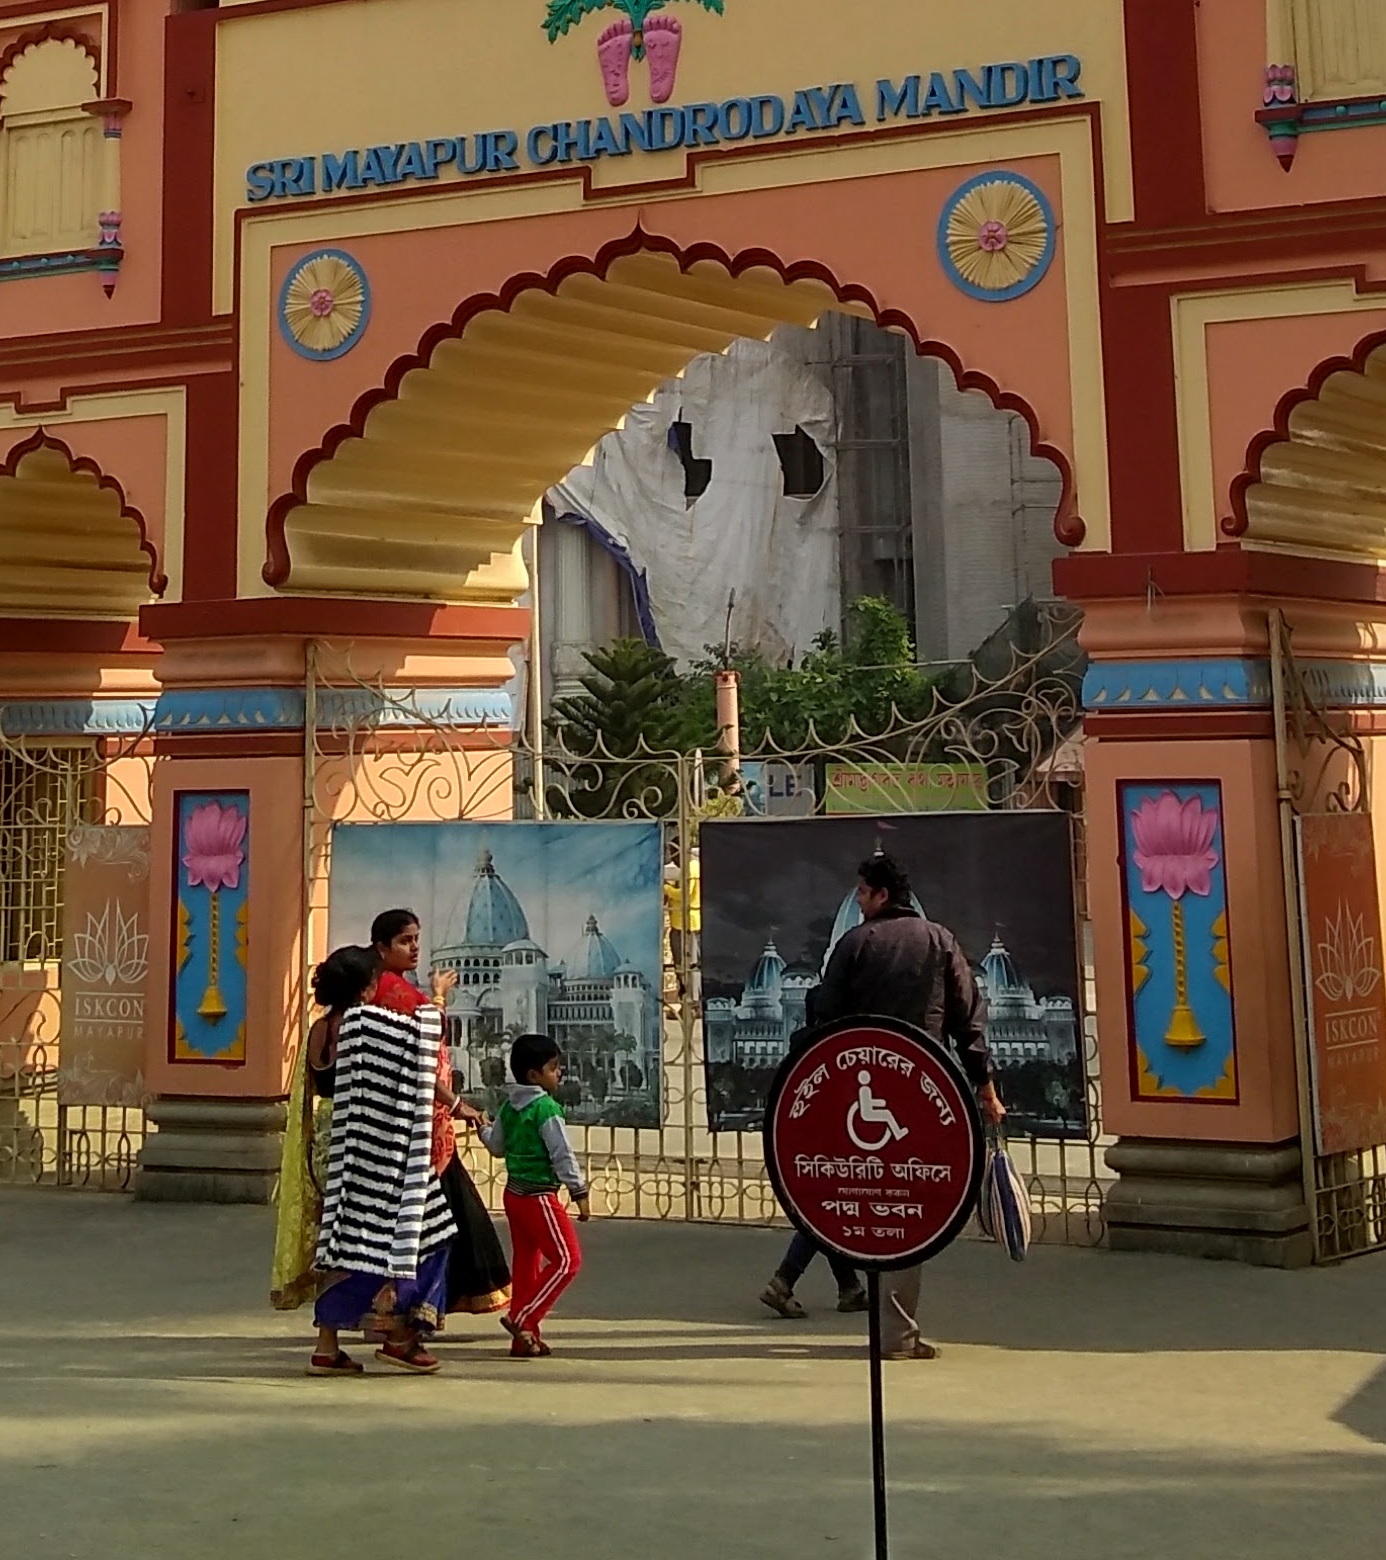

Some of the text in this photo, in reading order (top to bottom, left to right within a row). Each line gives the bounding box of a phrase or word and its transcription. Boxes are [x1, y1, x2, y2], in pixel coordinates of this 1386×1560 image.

[246, 54, 1085, 201] SRI MAYAPUR CHANDRODAYA MANDIR
[74, 997, 144, 1017] ISKCON
[74, 1025, 144, 1040] MAYAPUR
[1325, 1014, 1377, 1043] ISKCON
[836, 1045, 916, 1079] চেয়ারের
[919, 1070, 957, 1126] জন্য
[794, 1153, 952, 1183] সিকিউরিটি অফিসে
[821, 1199, 924, 1219] পদ্ম ভবন
